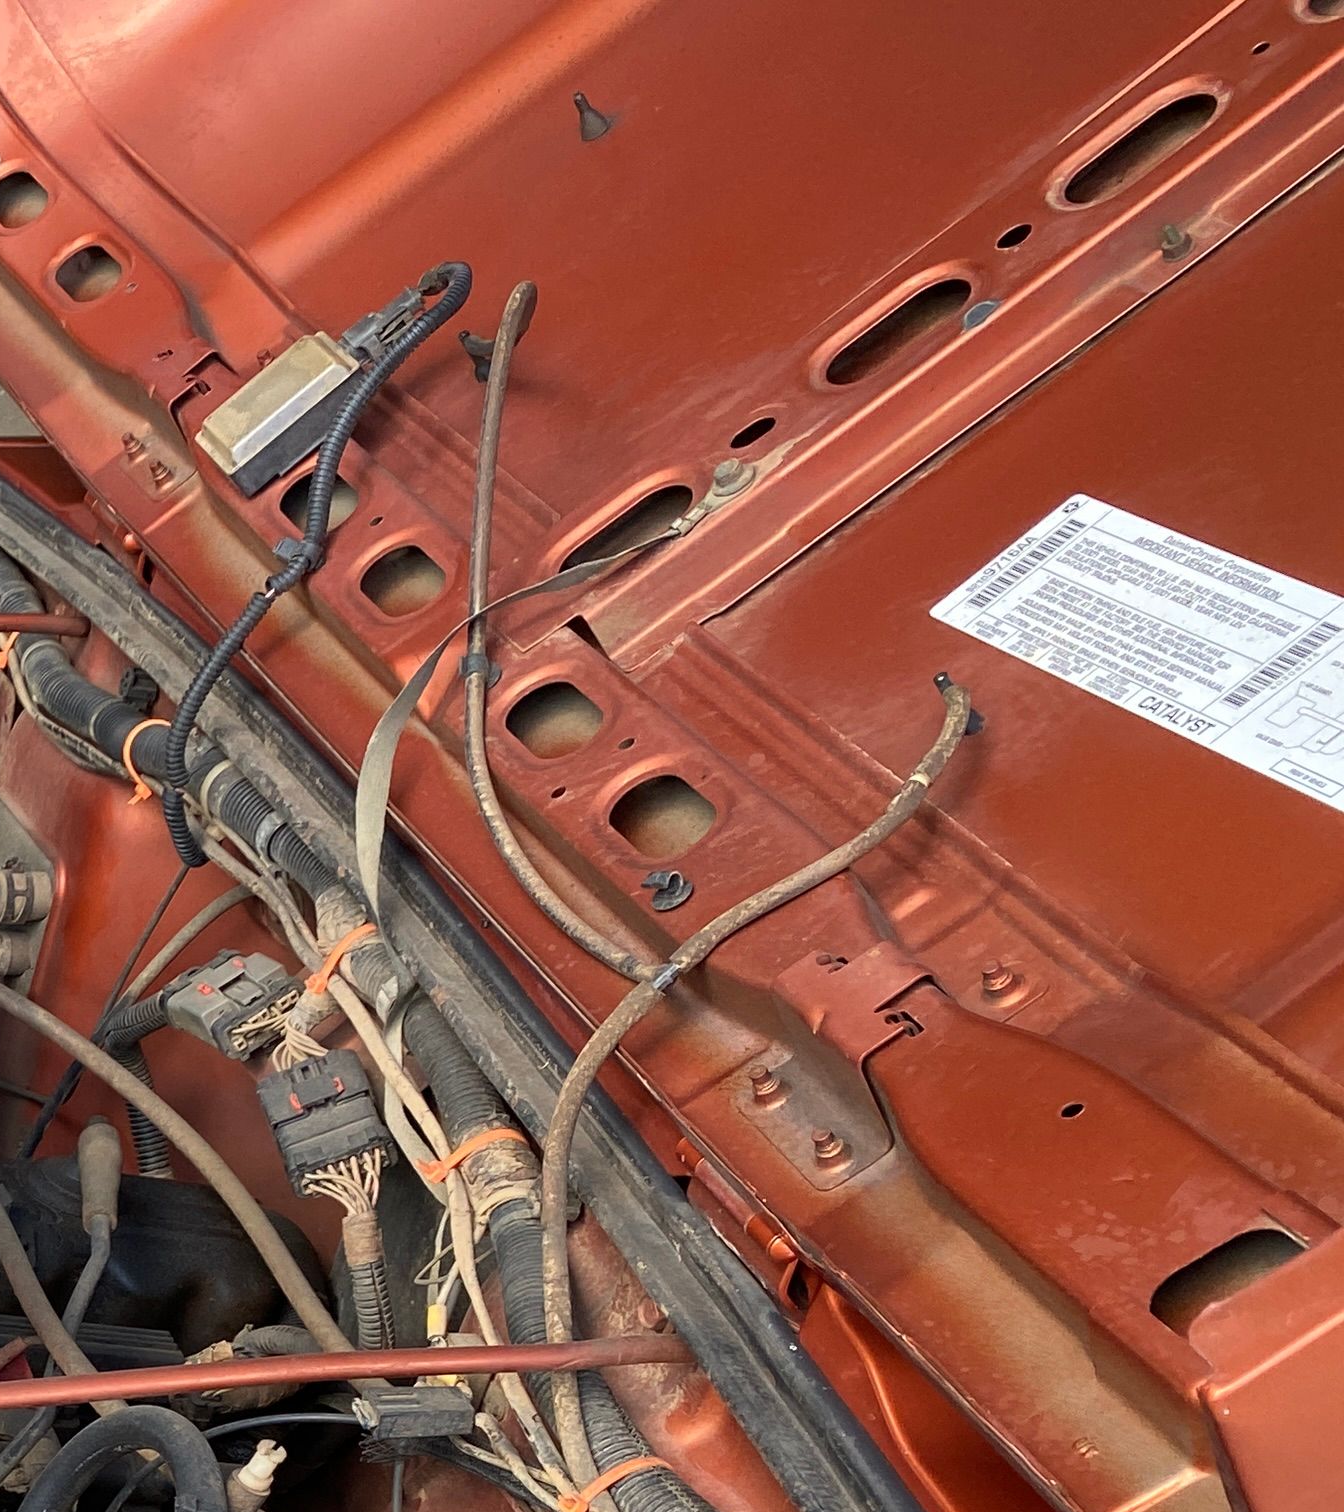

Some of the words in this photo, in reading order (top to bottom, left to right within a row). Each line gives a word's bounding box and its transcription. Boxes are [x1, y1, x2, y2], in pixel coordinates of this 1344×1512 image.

[1132, 537, 1185, 561] IMPORTANT
[1181, 556, 1221, 575] VEHICLE
[1218, 571, 1282, 600] INFORMATION
[1163, 535, 1224, 563] DaimlerChrysler
[1224, 559, 1271, 582] Corporation
[1138, 695, 1216, 736] CATALYST
